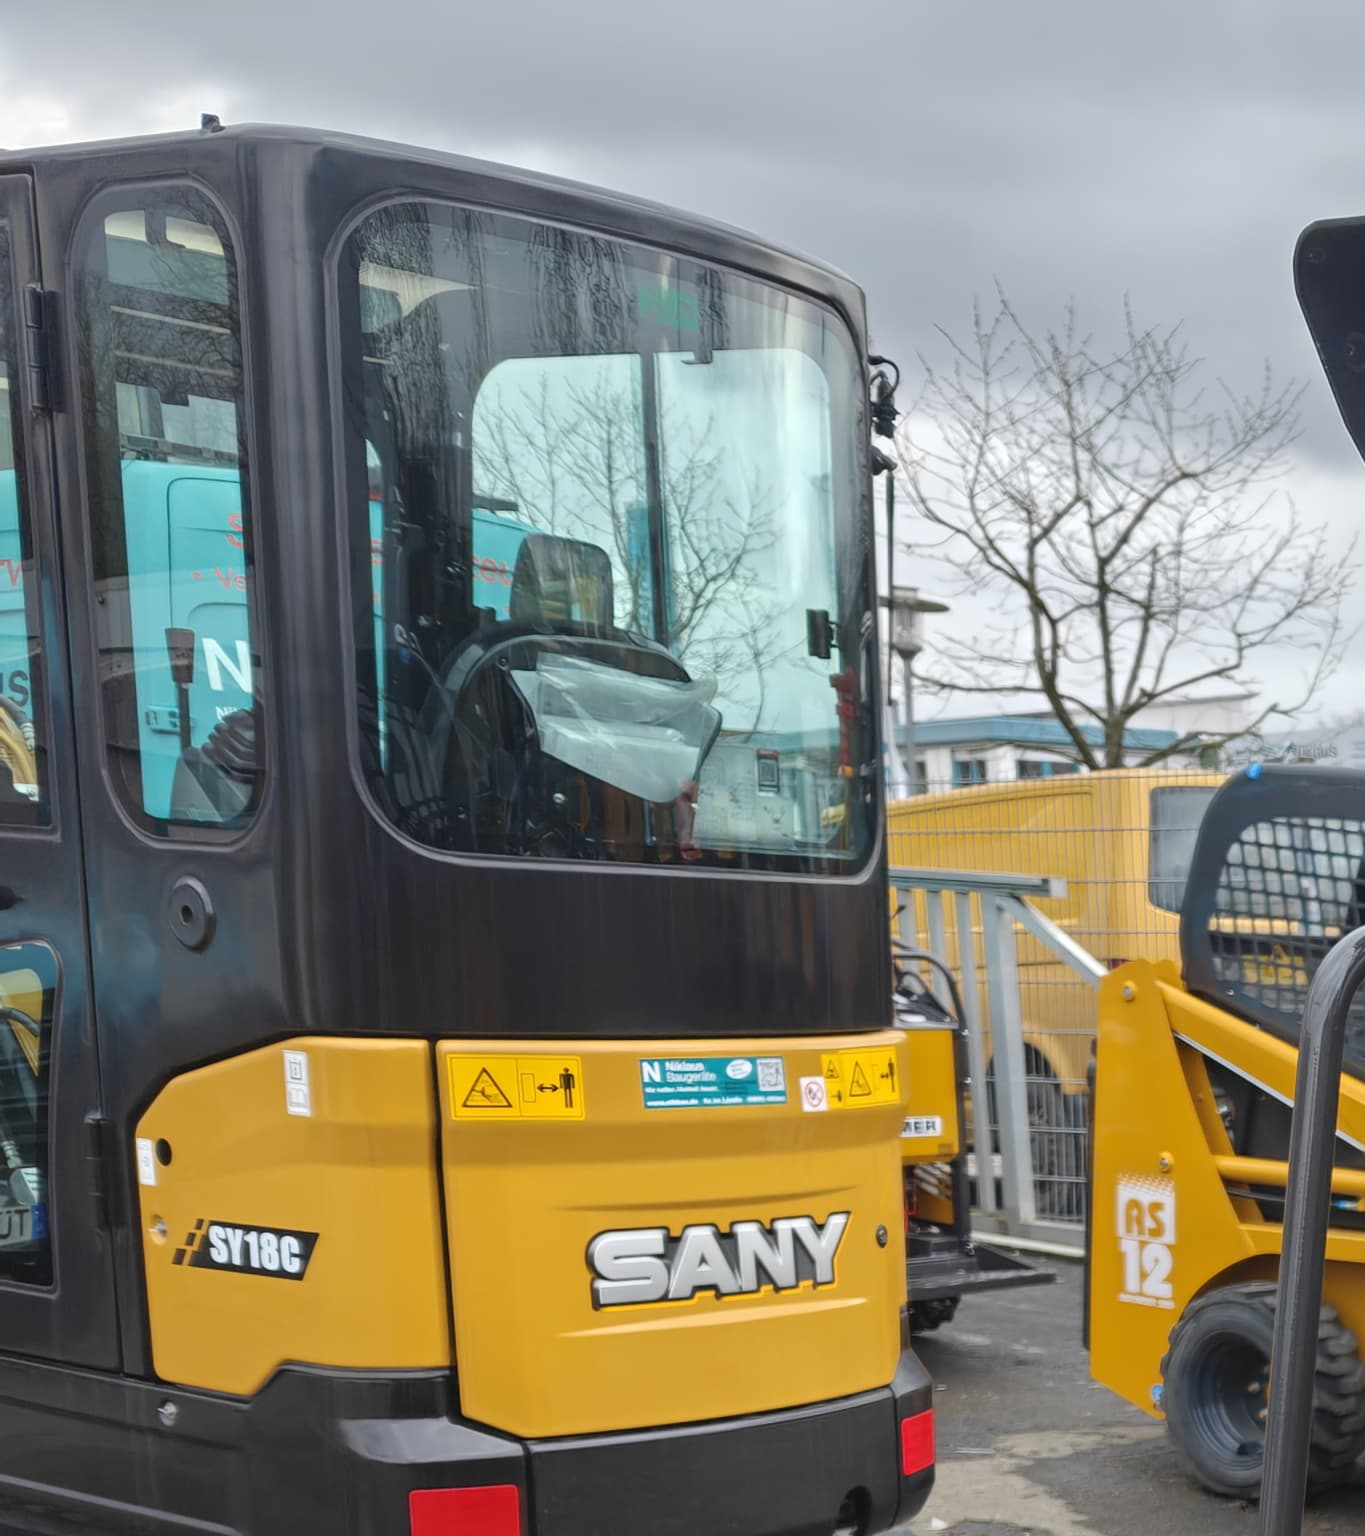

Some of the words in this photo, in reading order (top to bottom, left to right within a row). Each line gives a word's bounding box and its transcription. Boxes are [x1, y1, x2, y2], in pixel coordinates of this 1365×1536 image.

[642, 1061, 661, 1083] N
[208, 1224, 302, 1275] SY18C
[587, 1211, 850, 1308] SANY
[1119, 1239, 1173, 1299] 12
